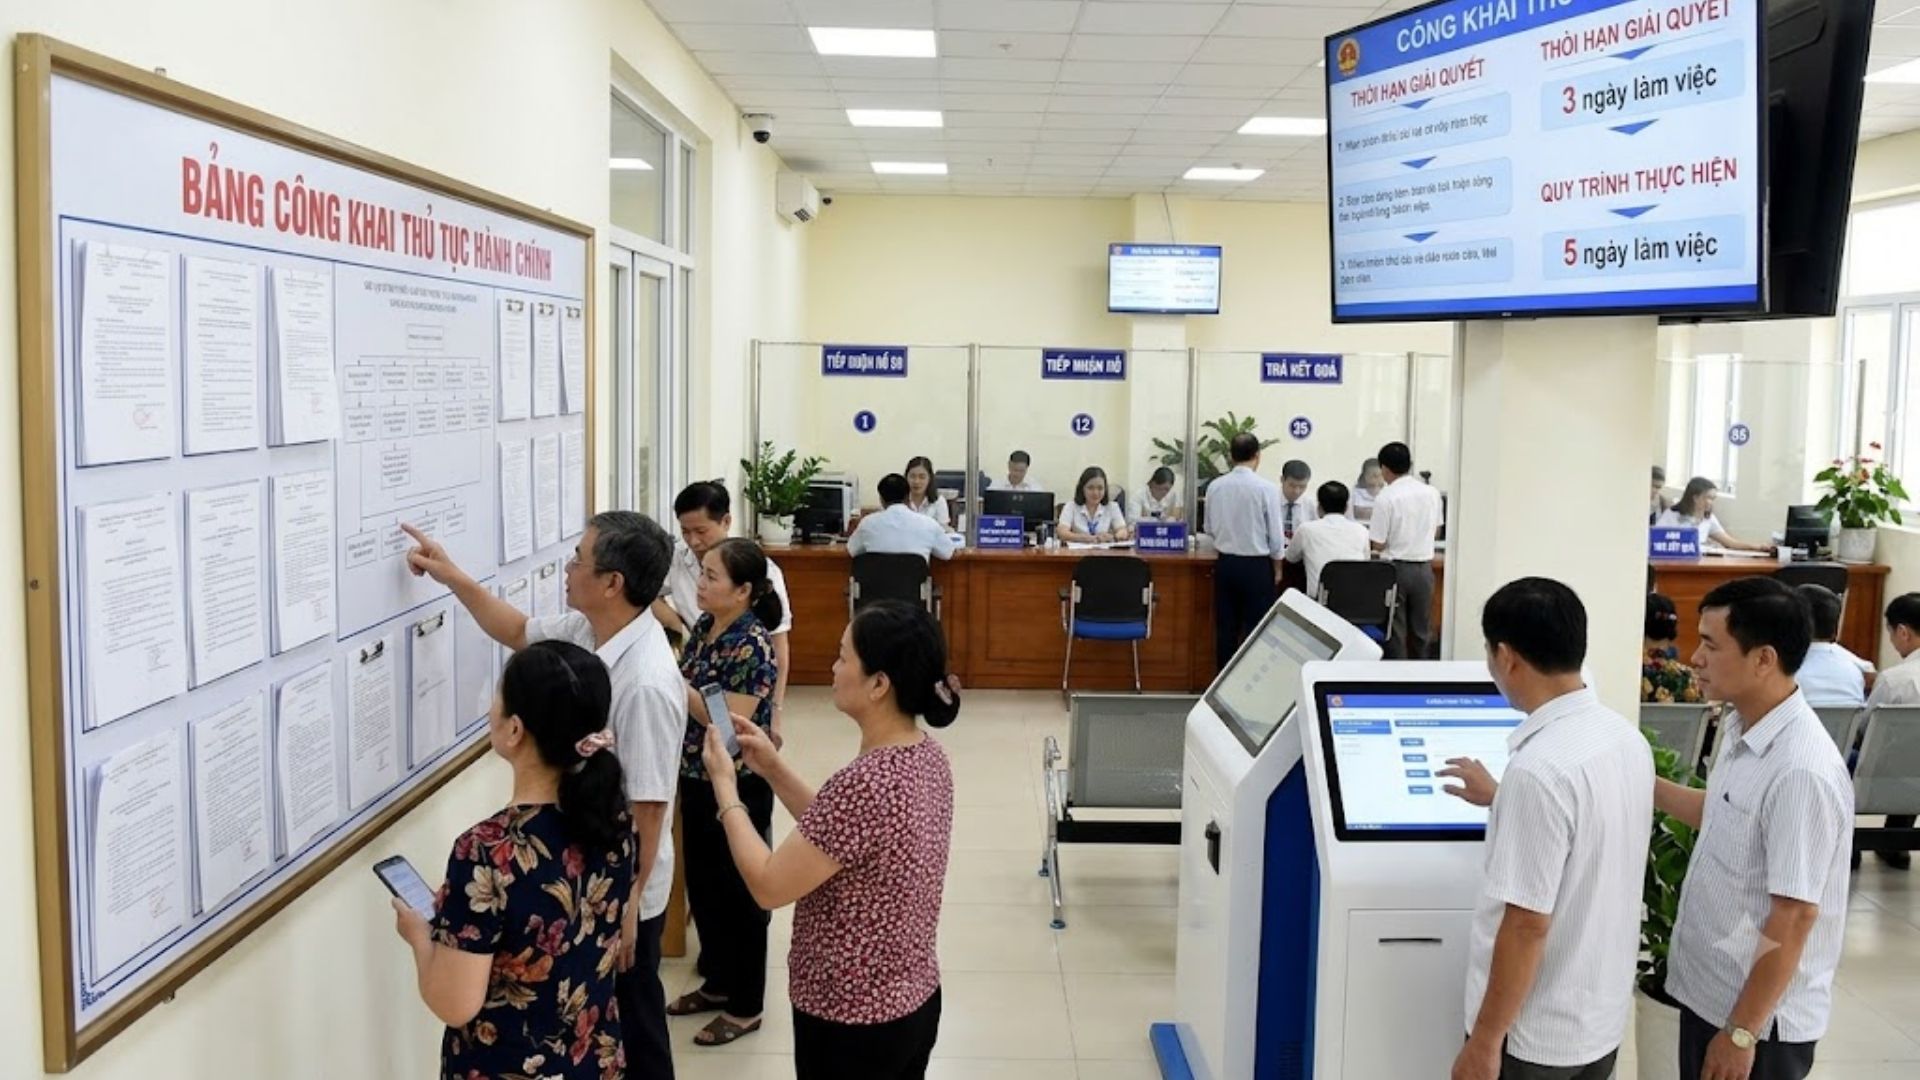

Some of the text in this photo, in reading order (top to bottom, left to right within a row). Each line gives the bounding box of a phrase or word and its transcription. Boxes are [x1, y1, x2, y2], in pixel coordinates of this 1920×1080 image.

[1396, 15, 1457, 53] CÔNG
[1463, 0, 1517, 35] KHAI
[1584, 23, 1620, 52] HẠN
[1625, 8, 1660, 39] GIẢI
[1381, 79, 1407, 103] HẠN
[1562, 63, 1717, 115] 3 ngày làm việc
[1541, 157, 1738, 203] QUY TRÌNH THỰC HIỆN
[181, 142, 553, 282] BẢNG CÔNG KHAI THỦ TỤC HÀNH CHÍNH
[1564, 238, 1578, 266] 5
[1676, 232, 1718, 263] việc
[1046, 353, 1072, 373] TIẾP
[861, 415, 869, 429] 1
[1075, 417, 1091, 432] 12
